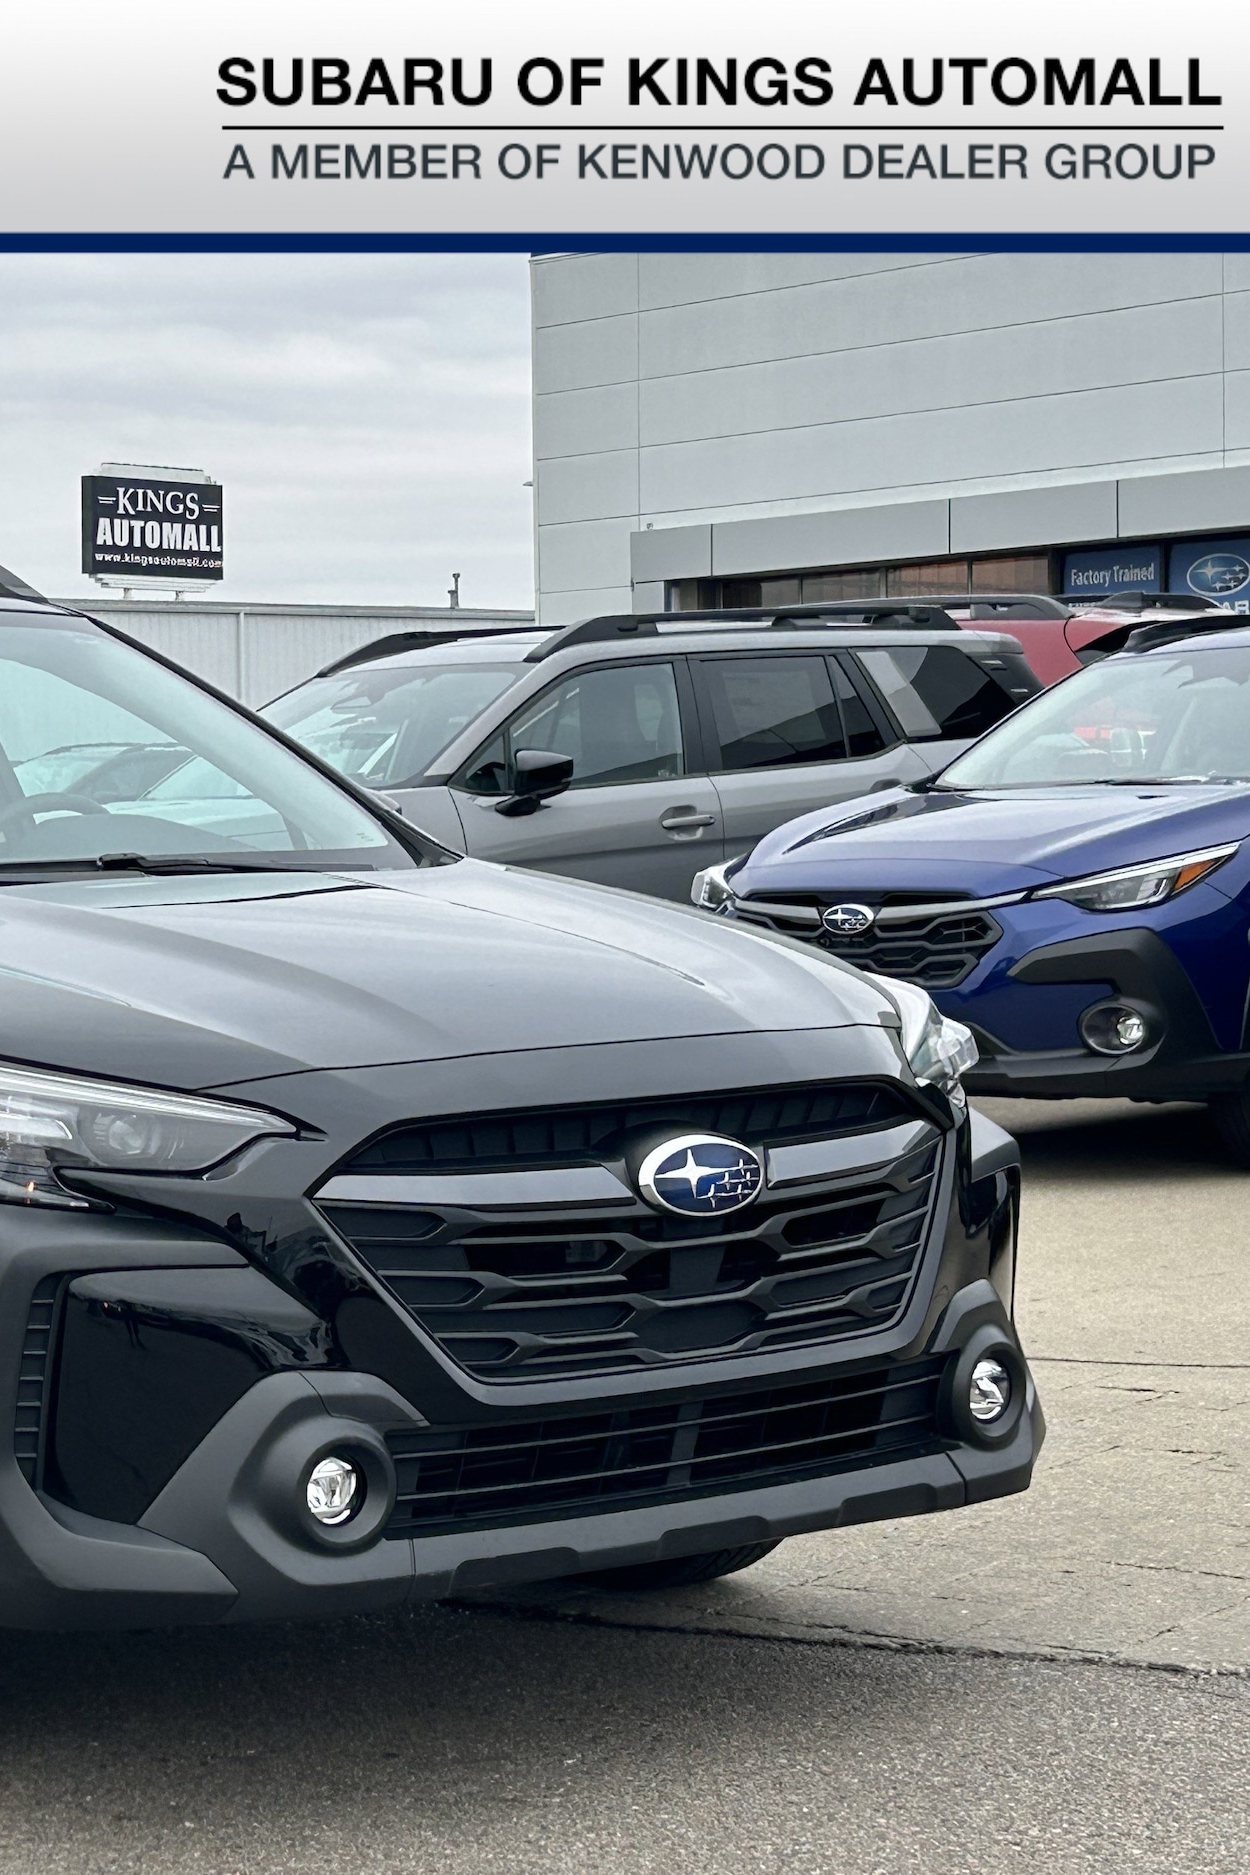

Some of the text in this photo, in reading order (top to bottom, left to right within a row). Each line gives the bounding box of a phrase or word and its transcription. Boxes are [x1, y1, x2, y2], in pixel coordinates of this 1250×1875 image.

[116, 487, 200, 520] KINGS
[96, 517, 222, 552] AUTOMALL
[1070, 562, 1155, 587] Factory Trained
